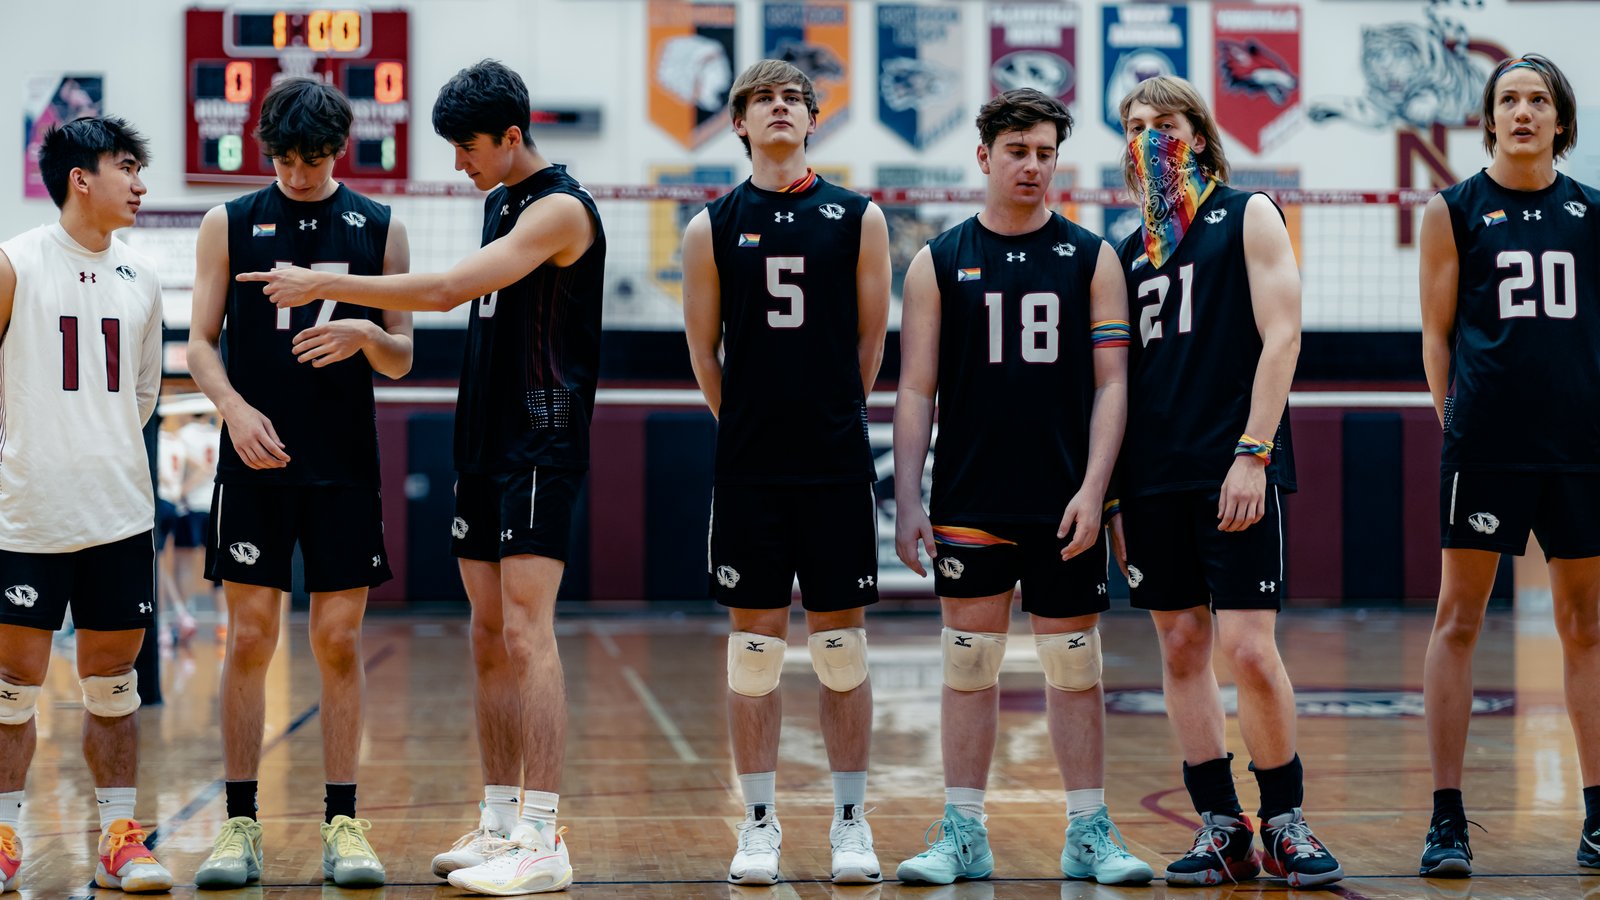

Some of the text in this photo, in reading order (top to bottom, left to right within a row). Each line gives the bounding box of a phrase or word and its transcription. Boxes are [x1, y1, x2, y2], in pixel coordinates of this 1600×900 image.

[225, 61, 253, 103] 0
[374, 61, 403, 104] 0
[766, 256, 805, 329] 5
[1137, 262, 1194, 348] 21
[1496, 250, 1577, 319] 20
[59, 315, 120, 393] 11
[984, 291, 1060, 364] 18
